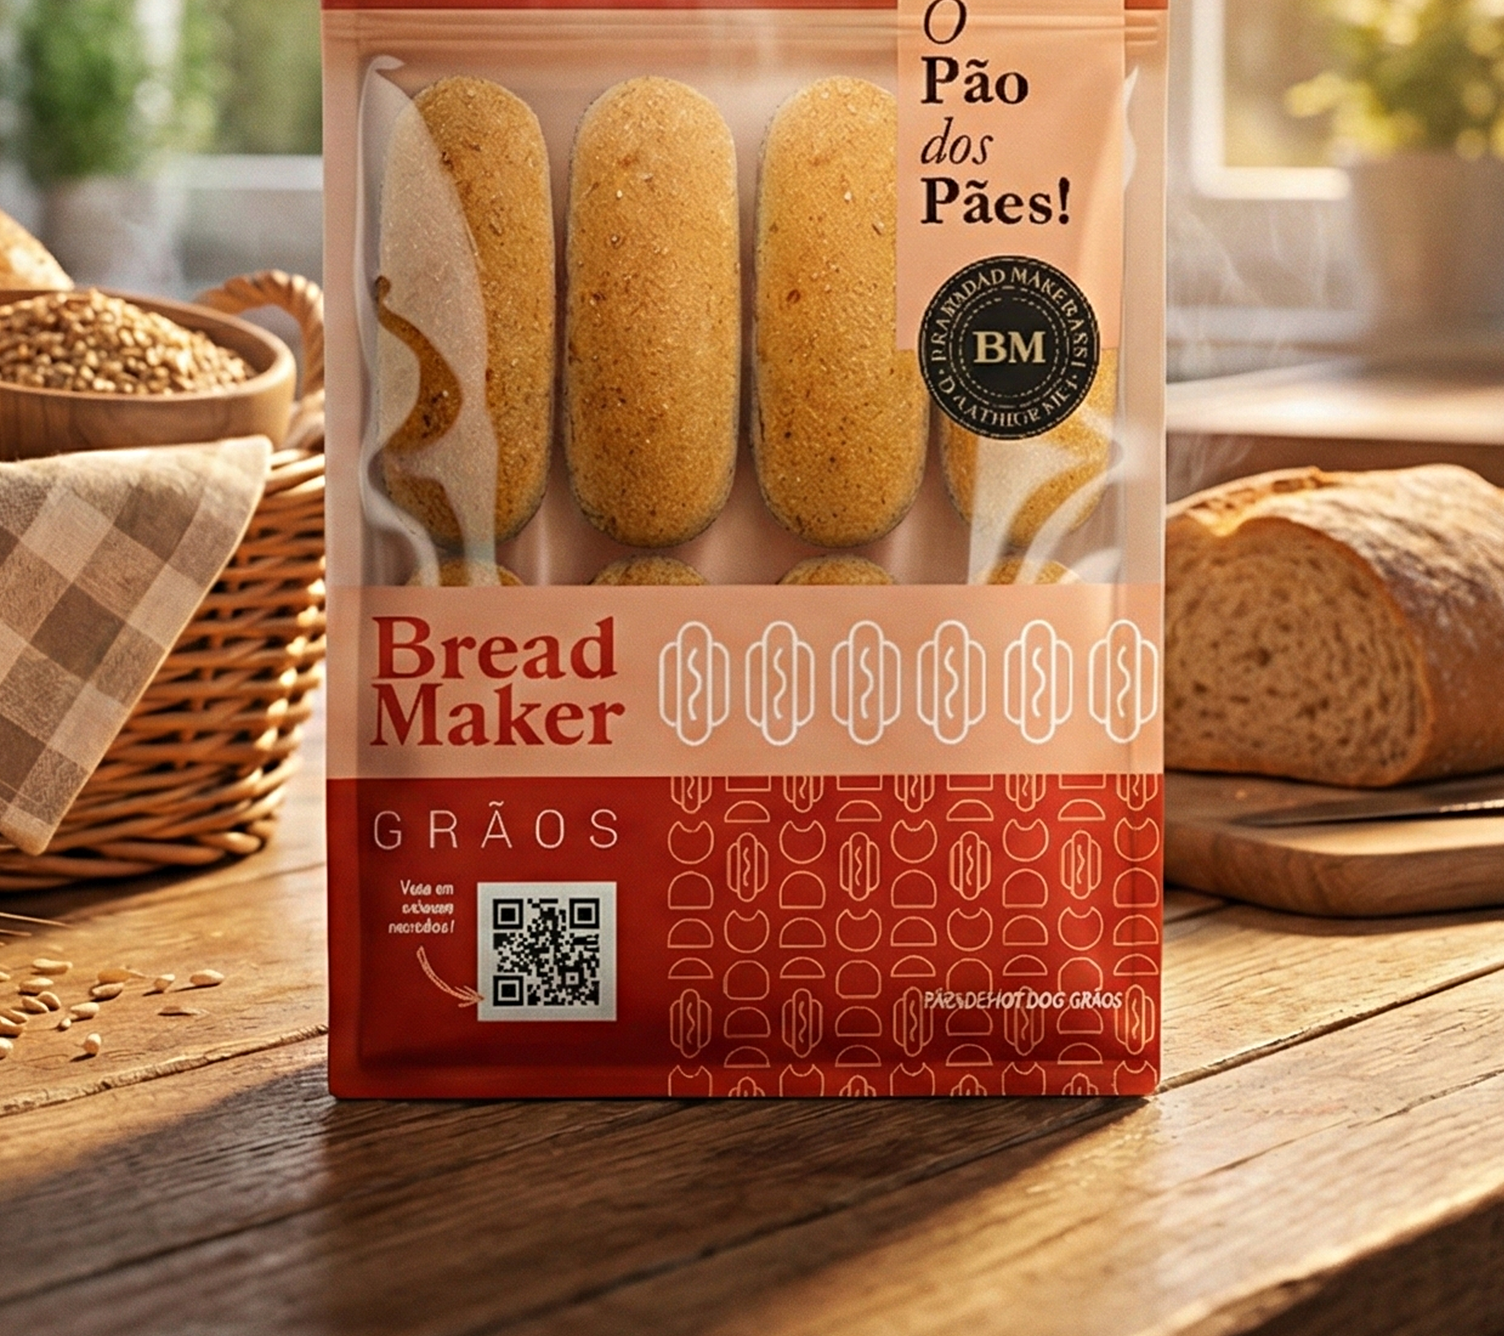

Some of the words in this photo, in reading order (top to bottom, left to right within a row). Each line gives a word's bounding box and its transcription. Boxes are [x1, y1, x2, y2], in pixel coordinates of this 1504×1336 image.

[921, 56, 1030, 105] Pão
[921, 116, 994, 165] dos
[921, 177, 1071, 225] Pães!
[972, 331, 1046, 363] BM
[371, 615, 618, 680] Bread
[370, 682, 626, 747] Maker
[373, 800, 618, 851] GRÃOS
